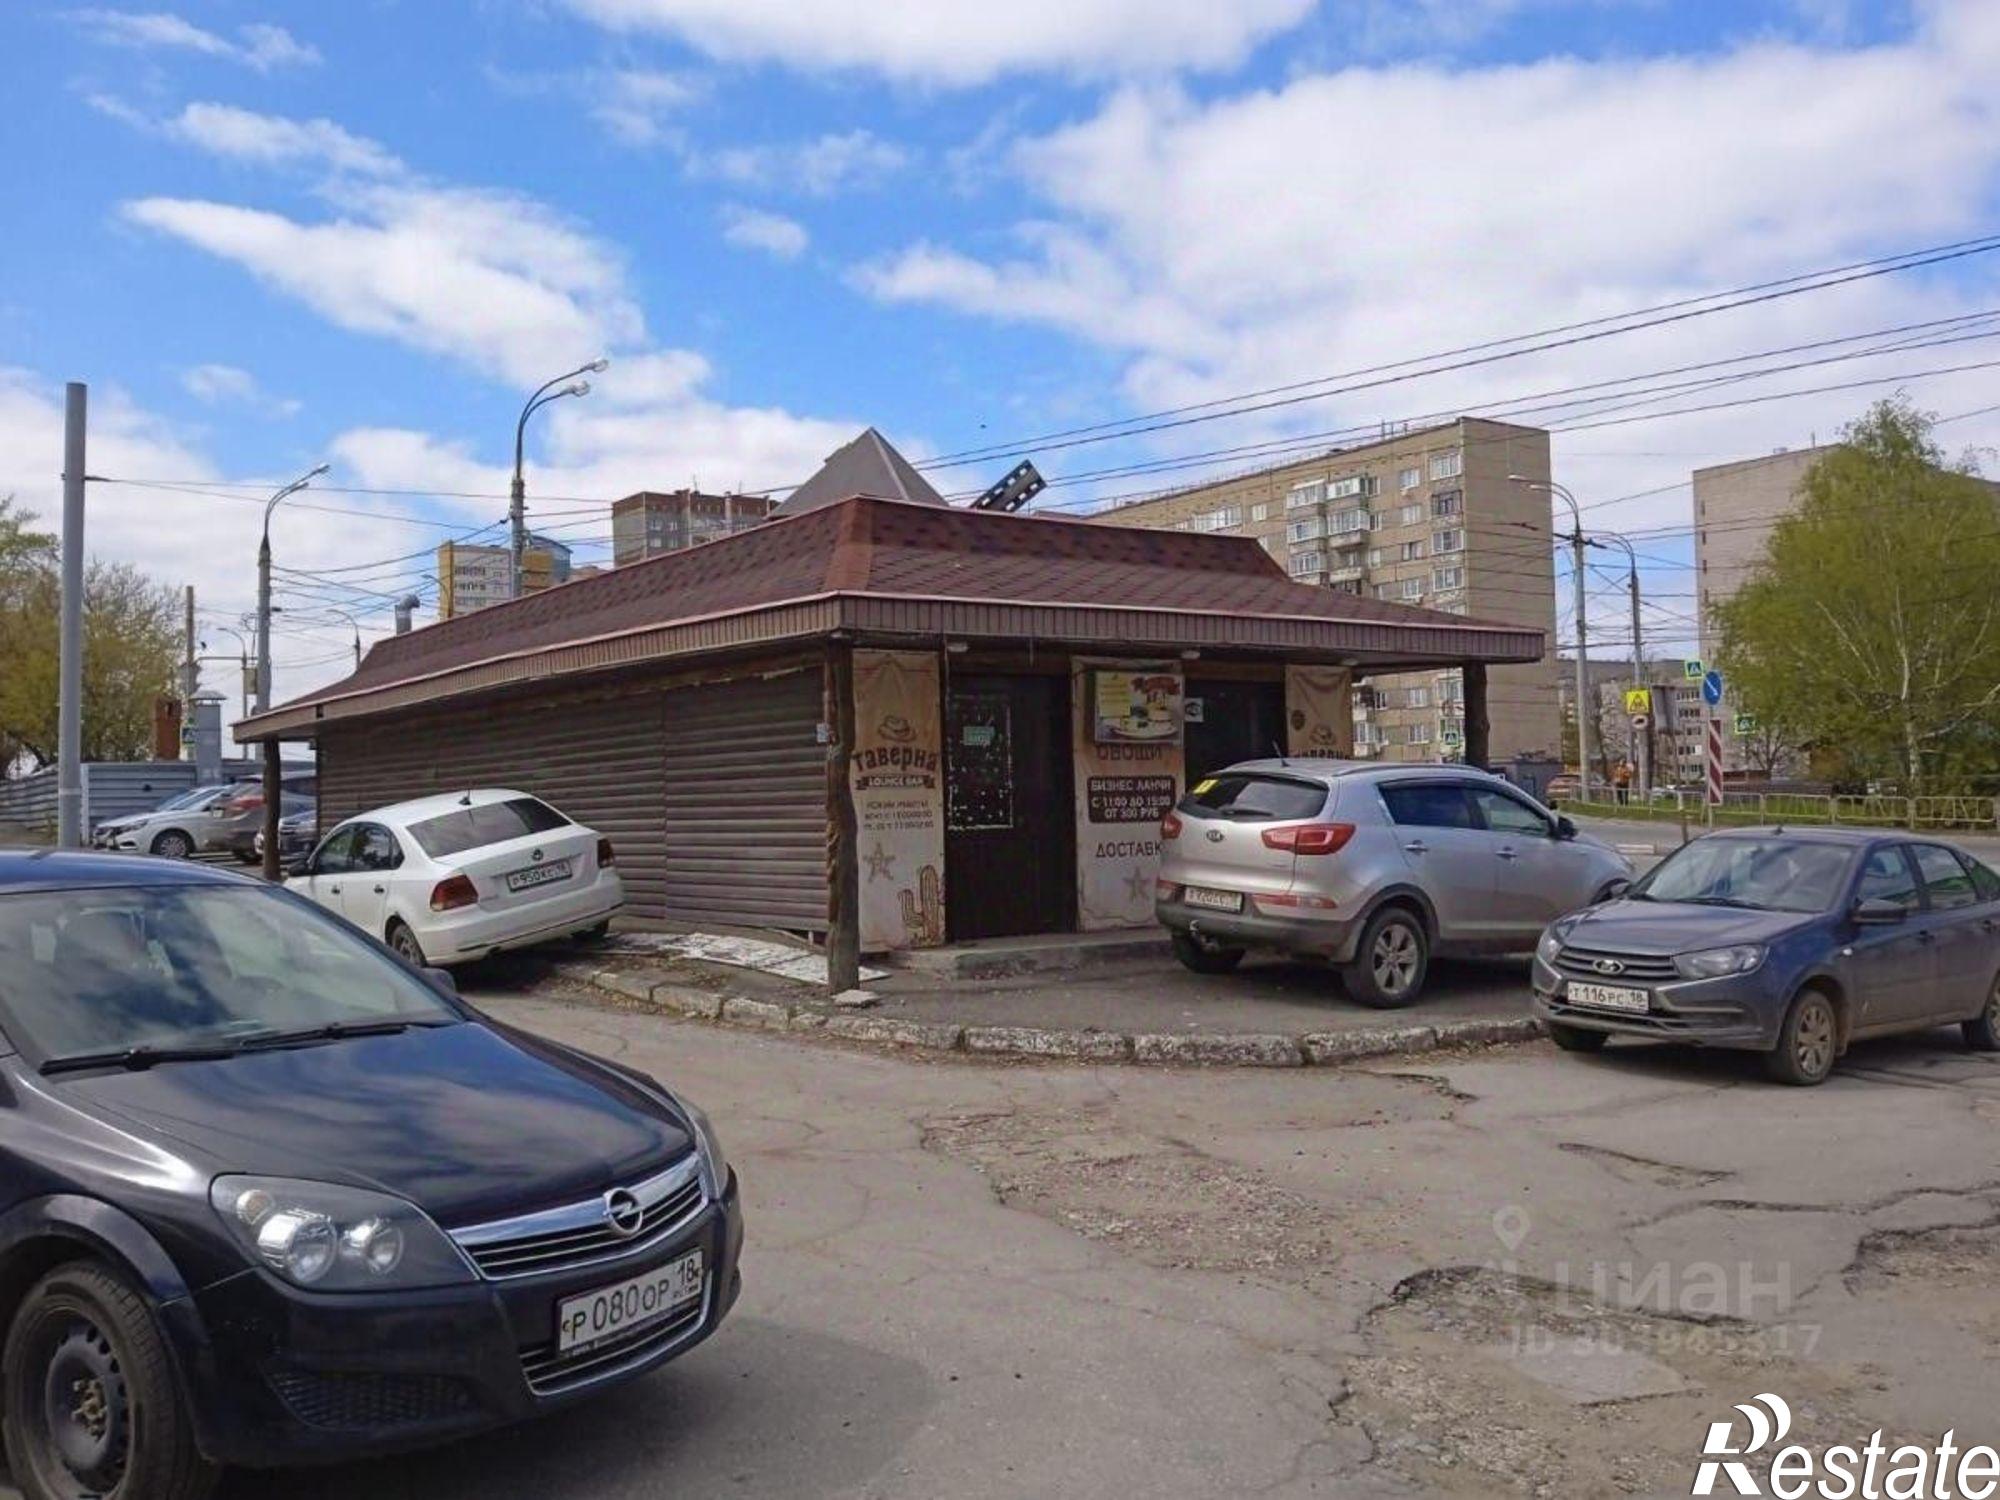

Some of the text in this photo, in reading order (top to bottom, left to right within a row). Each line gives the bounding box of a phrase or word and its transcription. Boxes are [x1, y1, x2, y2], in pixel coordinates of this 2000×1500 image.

[1091, 779, 1134, 791] БИЗНЕС
[1104, 808, 1118, 818] ОТ
[1096, 841, 1162, 857] ДОСТАВК
